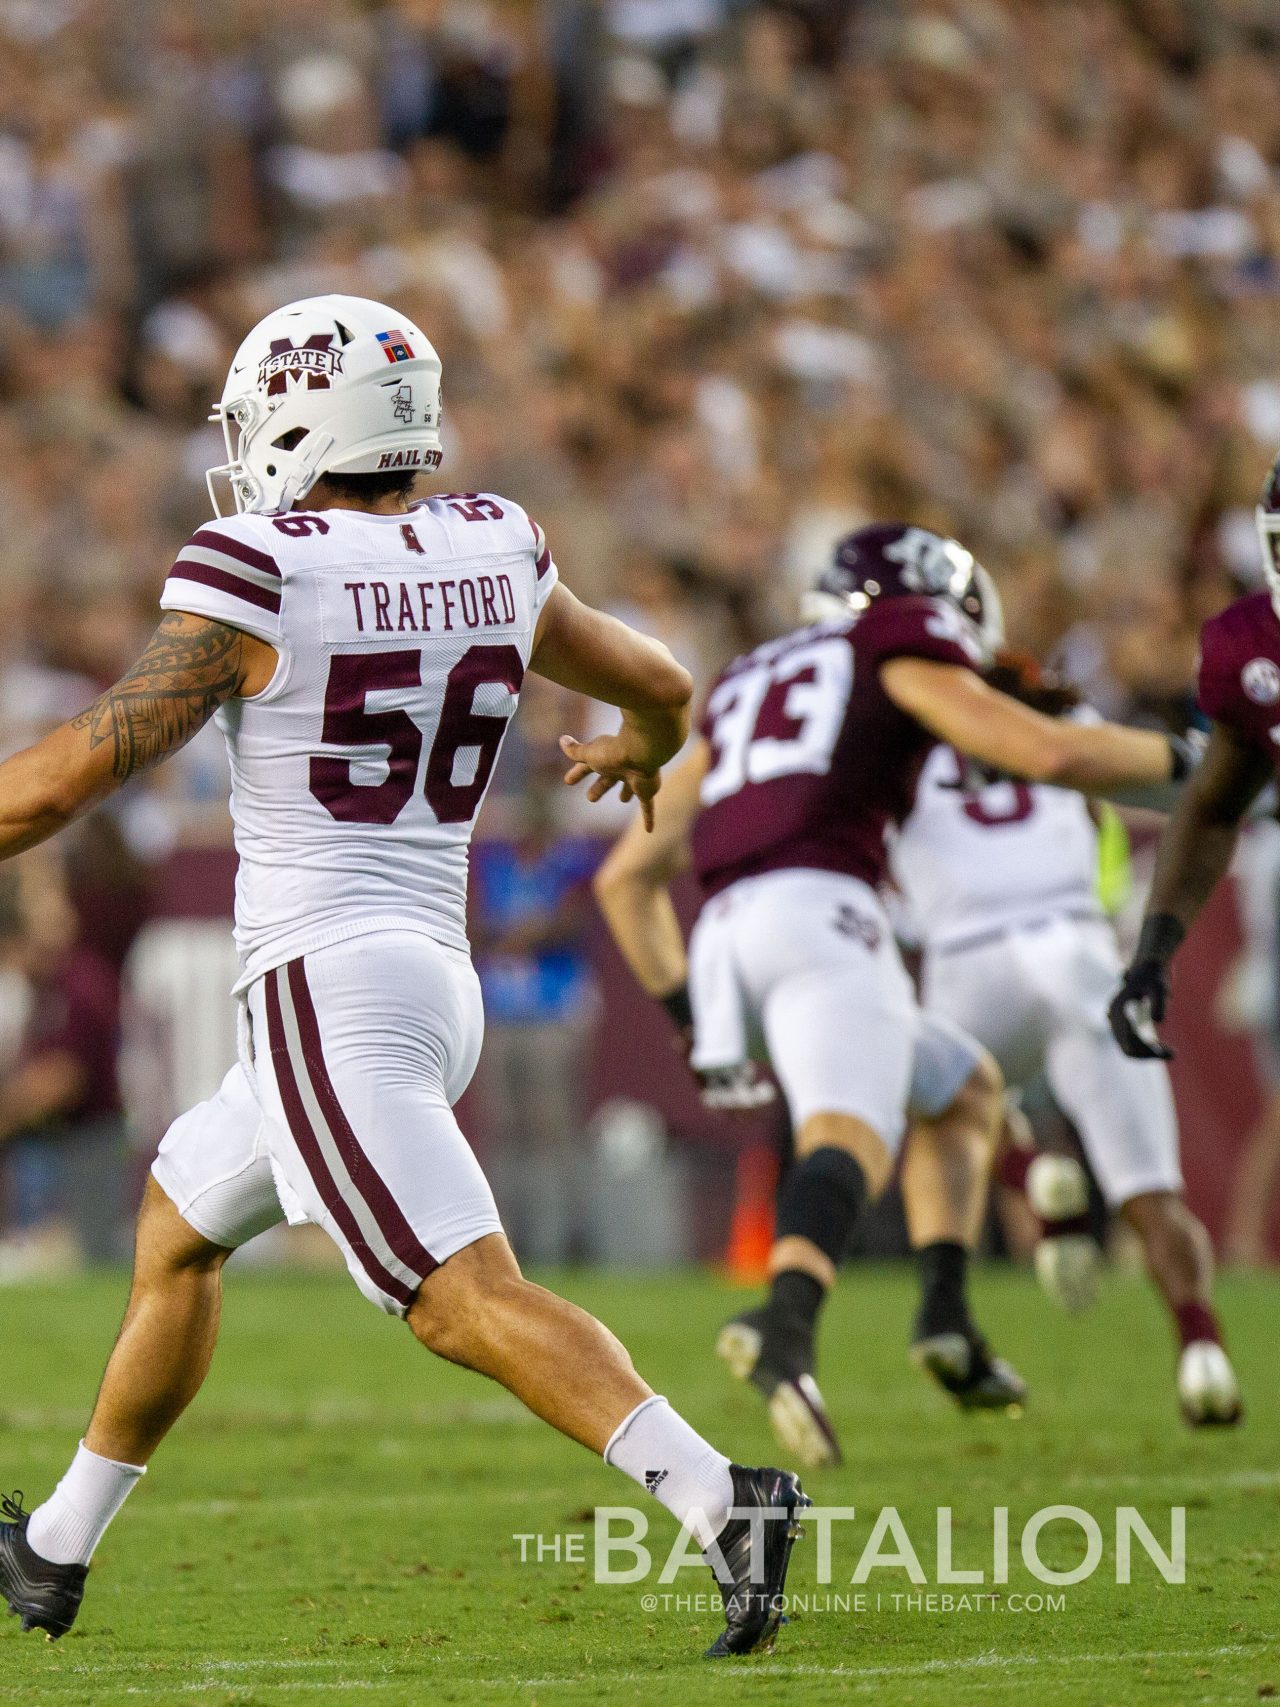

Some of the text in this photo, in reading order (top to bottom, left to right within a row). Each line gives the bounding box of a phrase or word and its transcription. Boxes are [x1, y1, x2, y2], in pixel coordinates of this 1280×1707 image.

[270, 351, 327, 374] STATE
[424, 413, 432, 423] 56
[377, 448, 421, 469] HAIL
[270, 512, 330, 538] 6
[344, 575, 516, 632] TRAFFORD
[699, 636, 855, 806] 33
[309, 645, 524, 824] 56
[649, 1468, 669, 1495] didas
